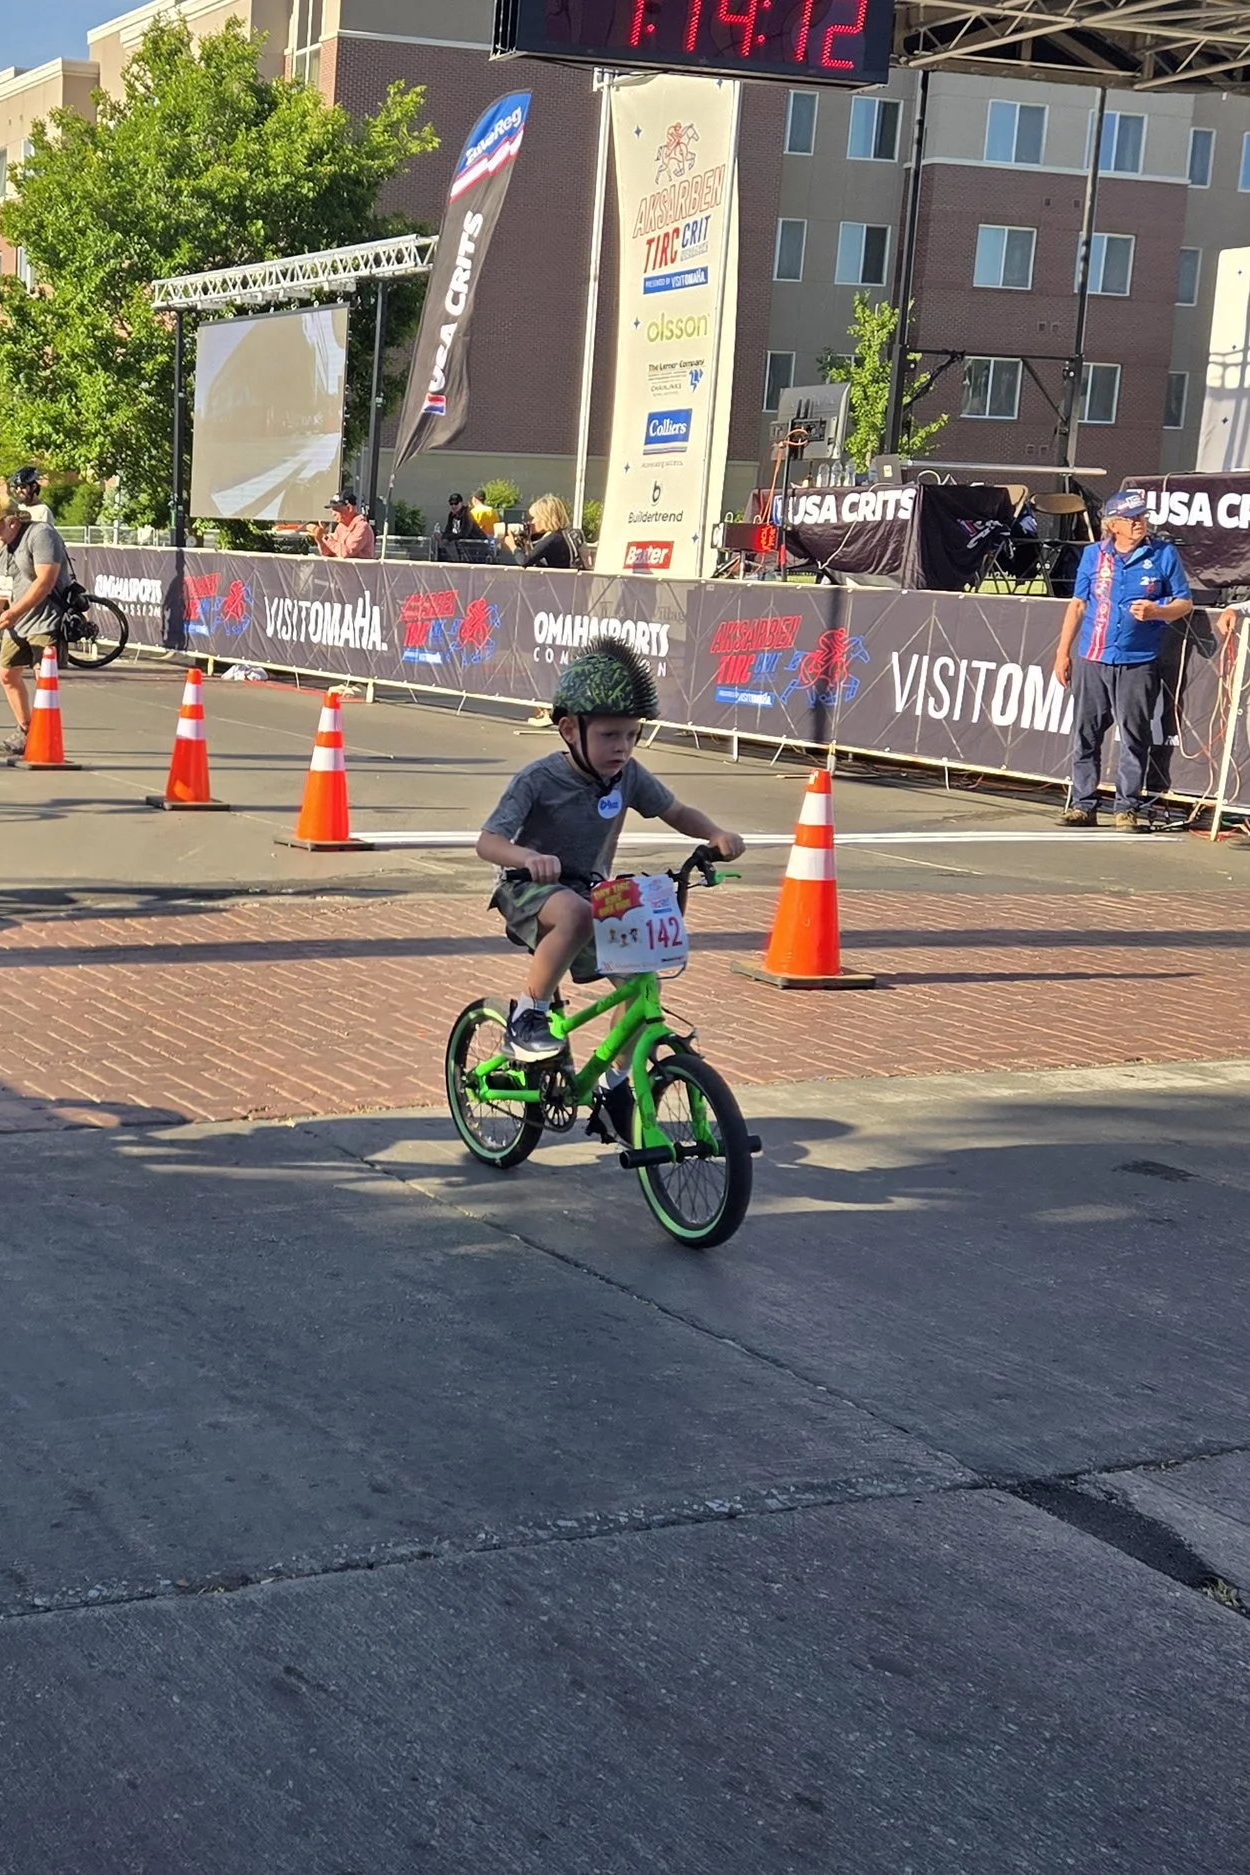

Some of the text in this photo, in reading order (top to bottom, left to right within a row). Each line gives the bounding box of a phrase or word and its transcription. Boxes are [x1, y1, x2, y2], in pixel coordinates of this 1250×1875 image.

[632, 163, 726, 239] AKSARBEN
[643, 226, 681, 274] TIRC
[681, 214, 712, 248] CRIT
[444, 210, 484, 317] CRITS
[647, 312, 708, 343] olsson
[649, 418, 687, 437] Colliers
[628, 510, 684, 524] Buildertrend
[787, 488, 916, 525] USA CRITS
[1146, 490, 1213, 528] USA
[626, 545, 669, 566] Baxter
[891, 651, 1075, 736] VISITOM
[646, 916, 683, 951] 142
